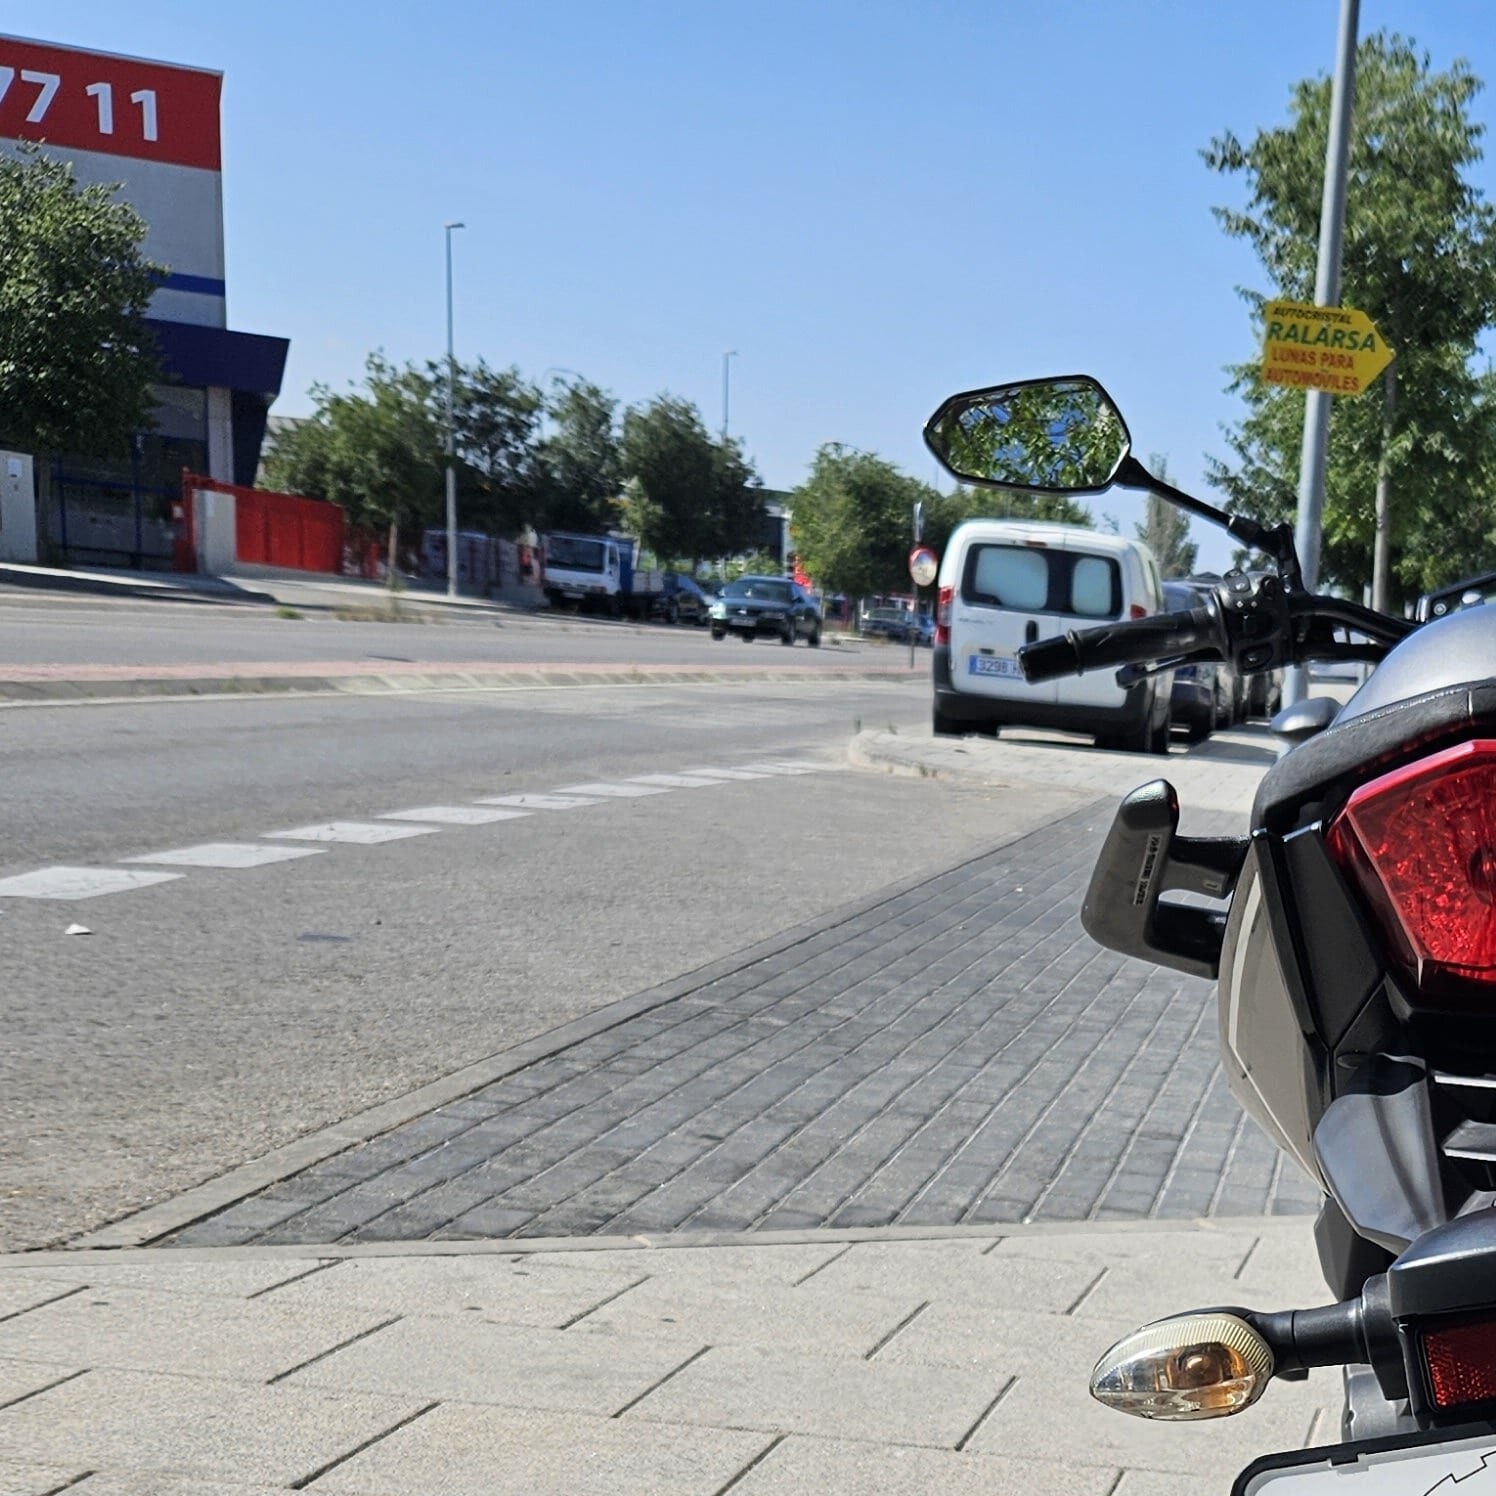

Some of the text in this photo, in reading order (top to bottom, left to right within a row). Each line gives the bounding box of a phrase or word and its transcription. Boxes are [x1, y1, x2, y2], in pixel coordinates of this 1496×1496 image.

[85, 82, 157, 141] 11
[1267, 321, 1376, 352] RALARSA
[1272, 346, 1354, 370] LUNAS PARA
